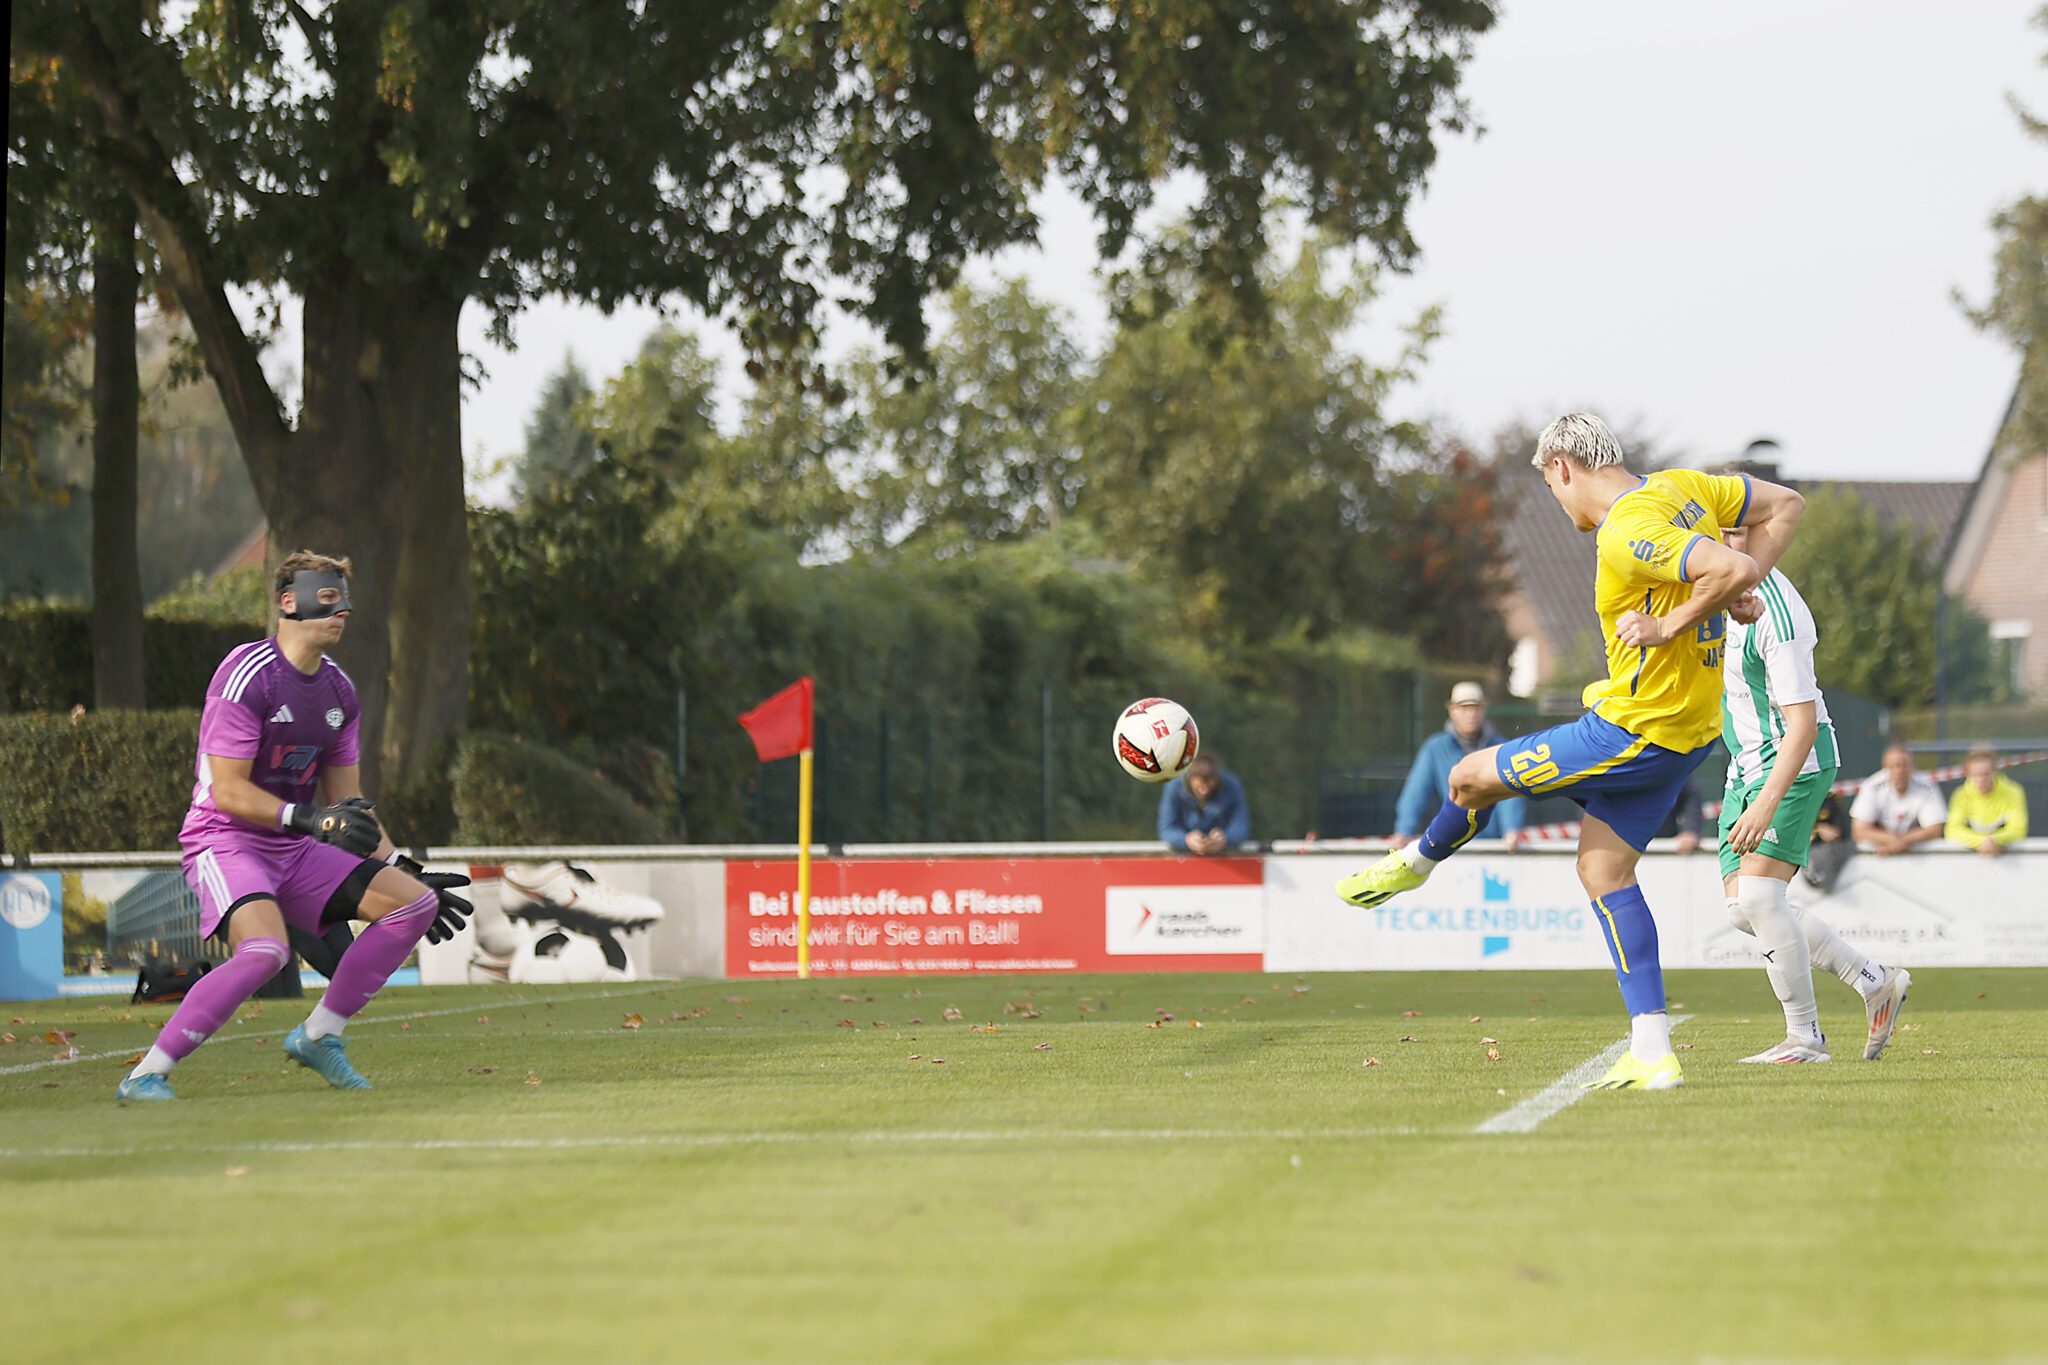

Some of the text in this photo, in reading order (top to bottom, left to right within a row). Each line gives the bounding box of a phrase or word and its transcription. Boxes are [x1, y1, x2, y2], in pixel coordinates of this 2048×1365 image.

[1502, 768, 1522, 789] JAKO
[1510, 743, 1560, 787] 20
[748, 890, 789, 916] Bei
[930, 889, 953, 915] &
[954, 888, 1043, 915] Fliesen
[748, 919, 1020, 947] sind wir für Sie am Ball!
[1374, 906, 1585, 932] TECKLENBURG
